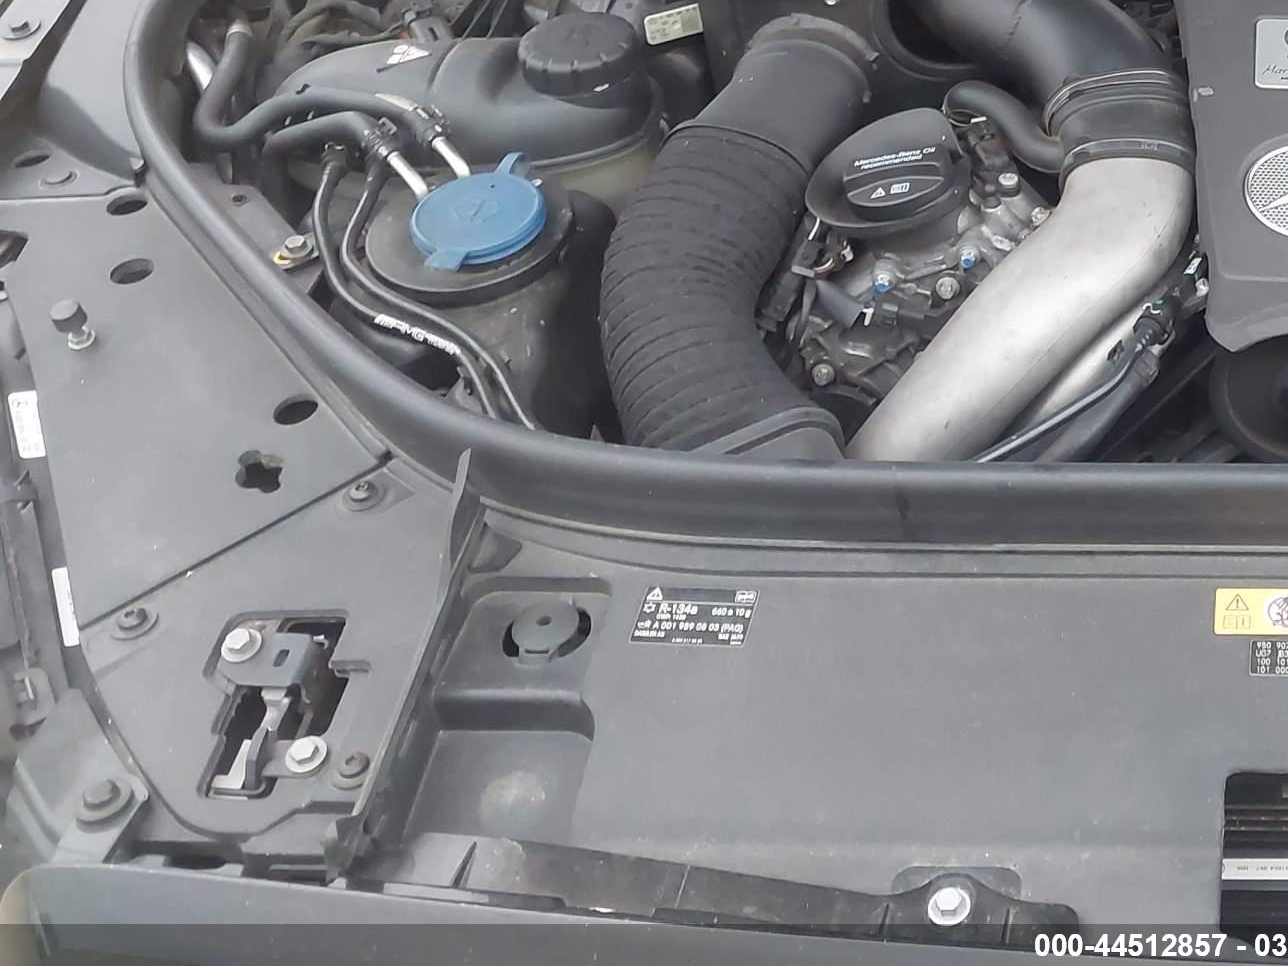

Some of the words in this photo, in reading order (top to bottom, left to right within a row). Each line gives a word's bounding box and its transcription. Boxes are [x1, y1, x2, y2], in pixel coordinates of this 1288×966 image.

[854, 149, 921, 167] Mercedes-Benz
[922, 146, 936, 155] Oil
[860, 154, 922, 170] recommended
[658, 603, 698, 615] R-134a
[735, 608, 744, 616] 10
[661, 622, 676, 630] 001
[679, 622, 694, 631] 989
[708, 623, 720, 632] 03
[720, 623, 744, 633] (PAG)
[1257, 657, 1271, 666] 100
[1257, 665, 1270, 674] 101
